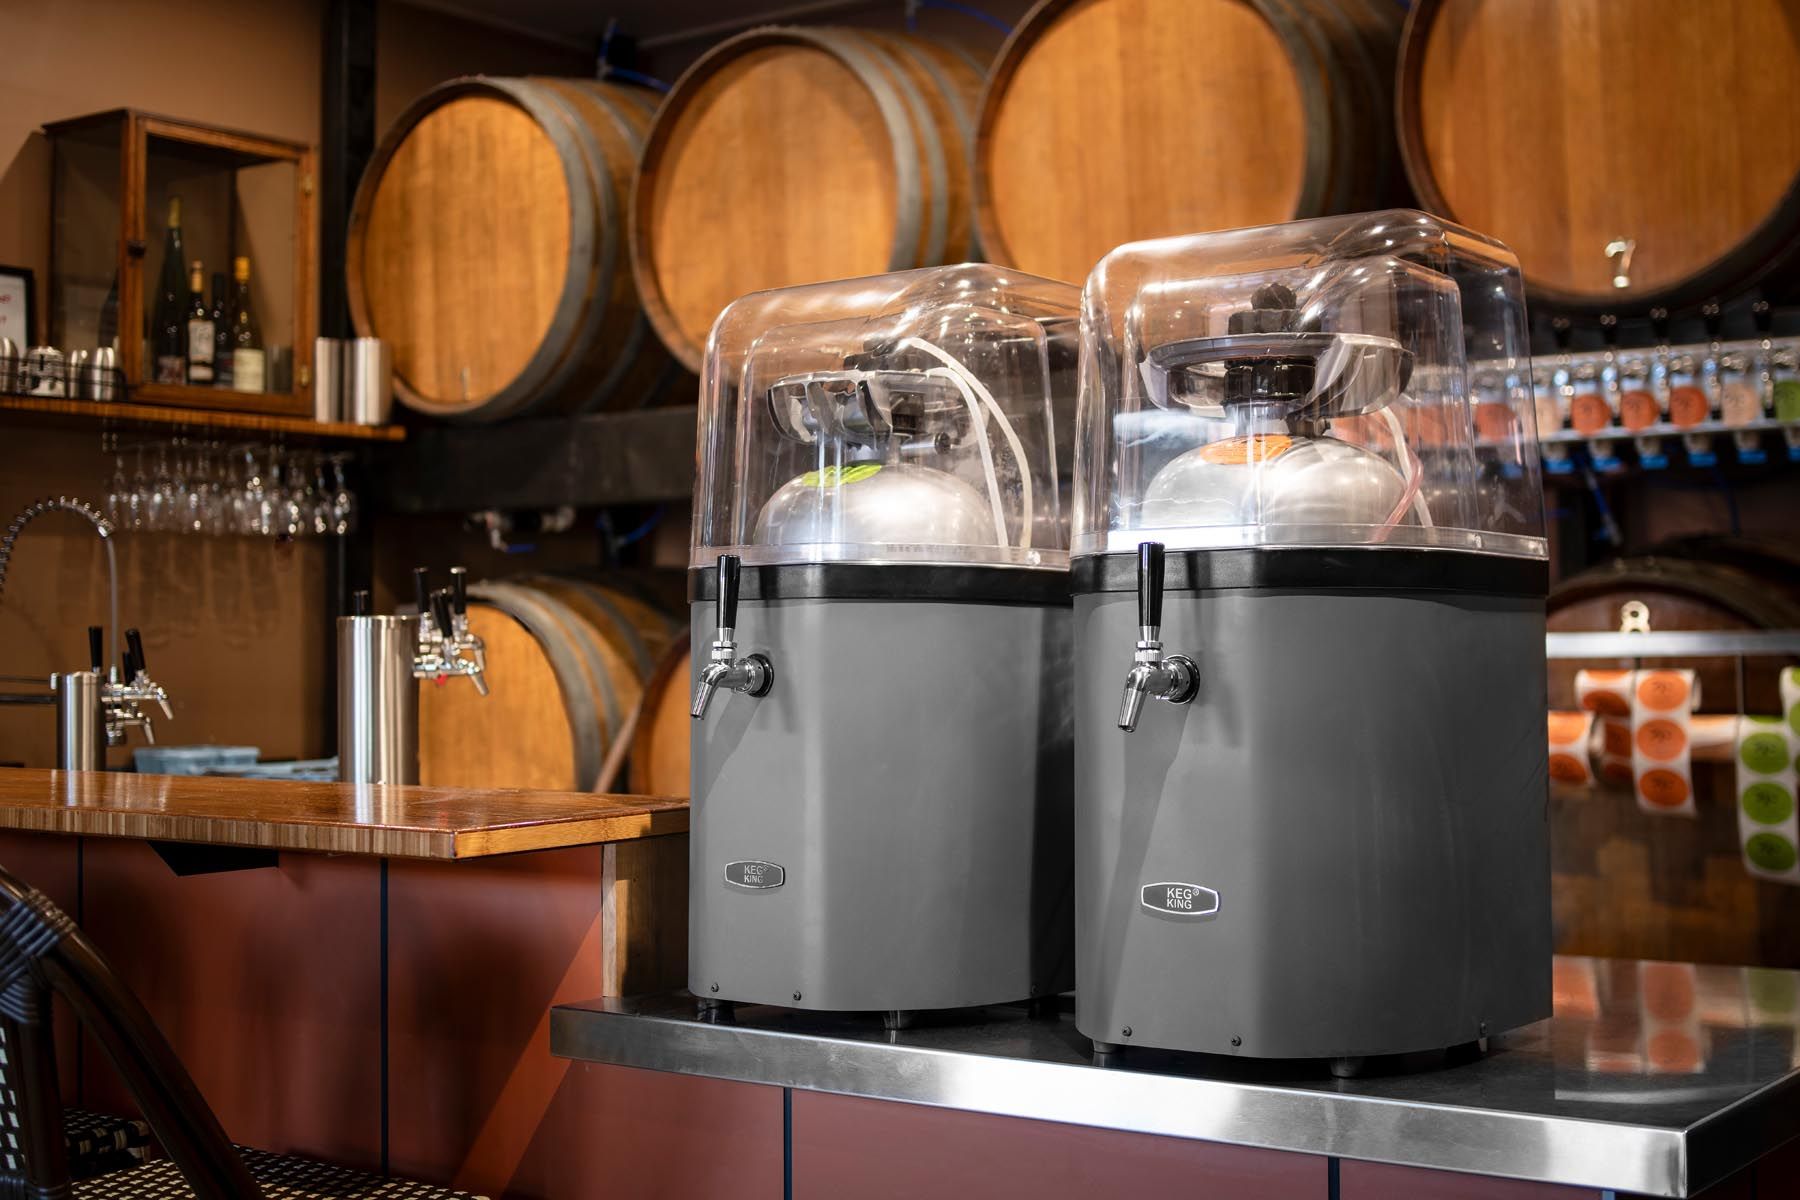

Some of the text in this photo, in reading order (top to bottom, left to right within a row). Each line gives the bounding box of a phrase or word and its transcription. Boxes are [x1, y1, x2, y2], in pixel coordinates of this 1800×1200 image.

[1605, 240, 1636, 289] 7
[743, 874, 764, 884] KING
[1166, 898, 1192, 910] KING
